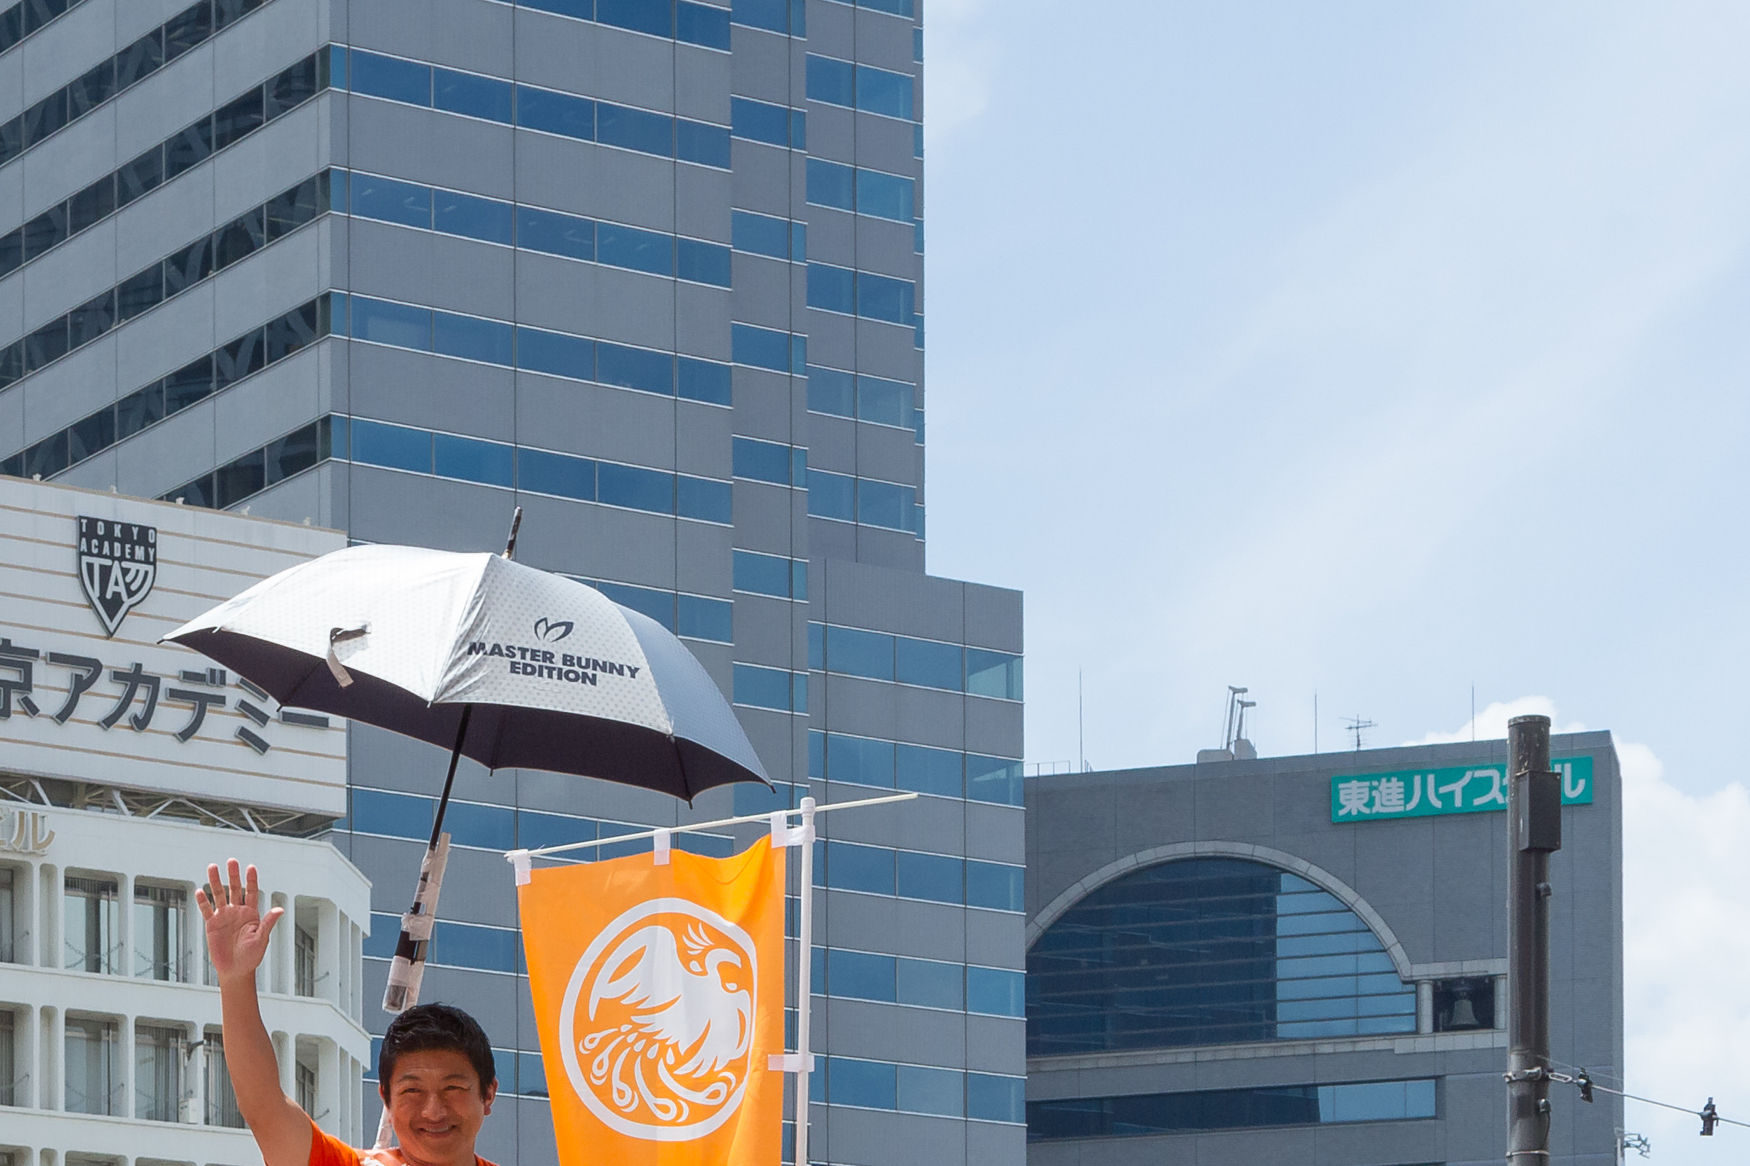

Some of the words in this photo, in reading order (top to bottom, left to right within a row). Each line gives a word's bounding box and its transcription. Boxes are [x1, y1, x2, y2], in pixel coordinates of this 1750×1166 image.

[81, 518, 156, 544] TOKYO
[80, 537, 155, 562] ACADEMY
[467, 641, 555, 664] MASTER
[562, 653, 641, 679] BUNNY
[509, 660, 598, 686] EDITION
[1338, 762, 1586, 817] 東進ハイスル
